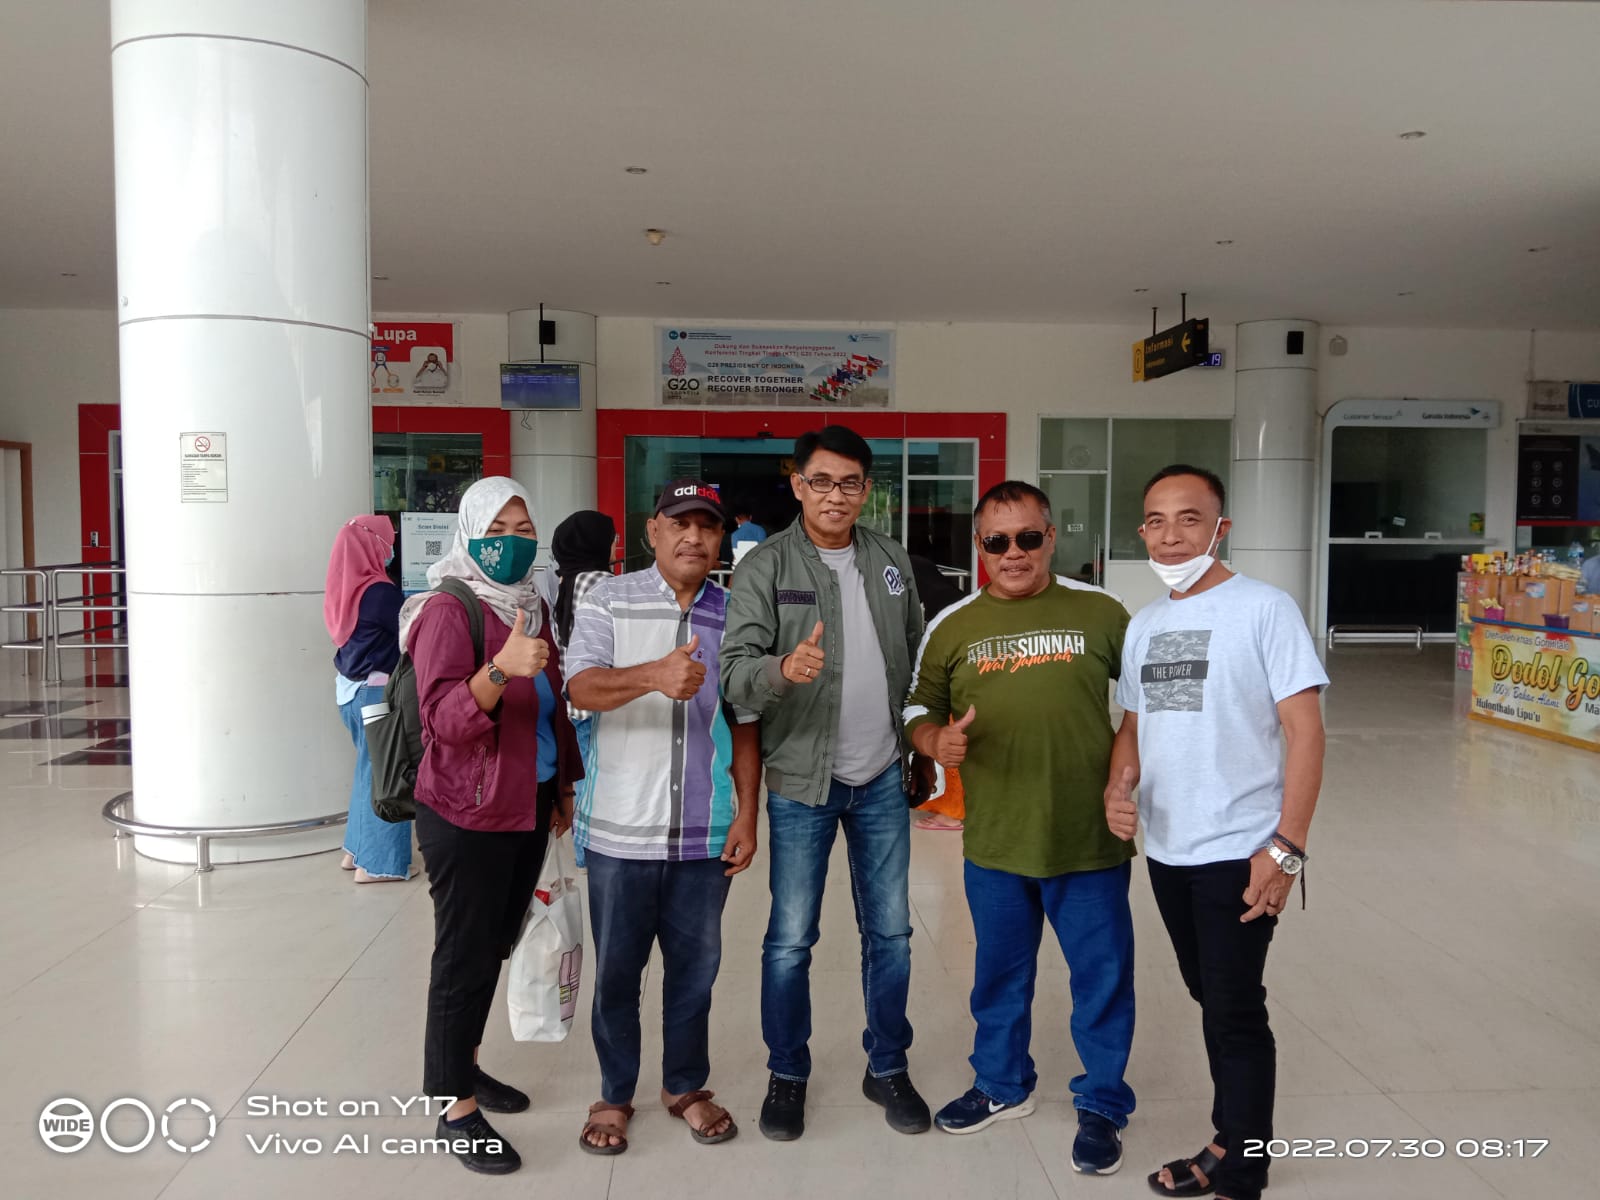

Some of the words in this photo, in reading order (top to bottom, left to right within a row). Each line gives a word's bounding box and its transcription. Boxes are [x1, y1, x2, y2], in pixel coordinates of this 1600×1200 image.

[373, 326, 417, 344] Lupa
[667, 378, 700, 391] G20
[707, 375, 752, 383] RECOVER
[754, 376, 804, 384] TOGETHER
[707, 385, 752, 393] RECOVER
[1151, 665, 1168, 679] THE
[1491, 644, 1562, 692] Dodol
